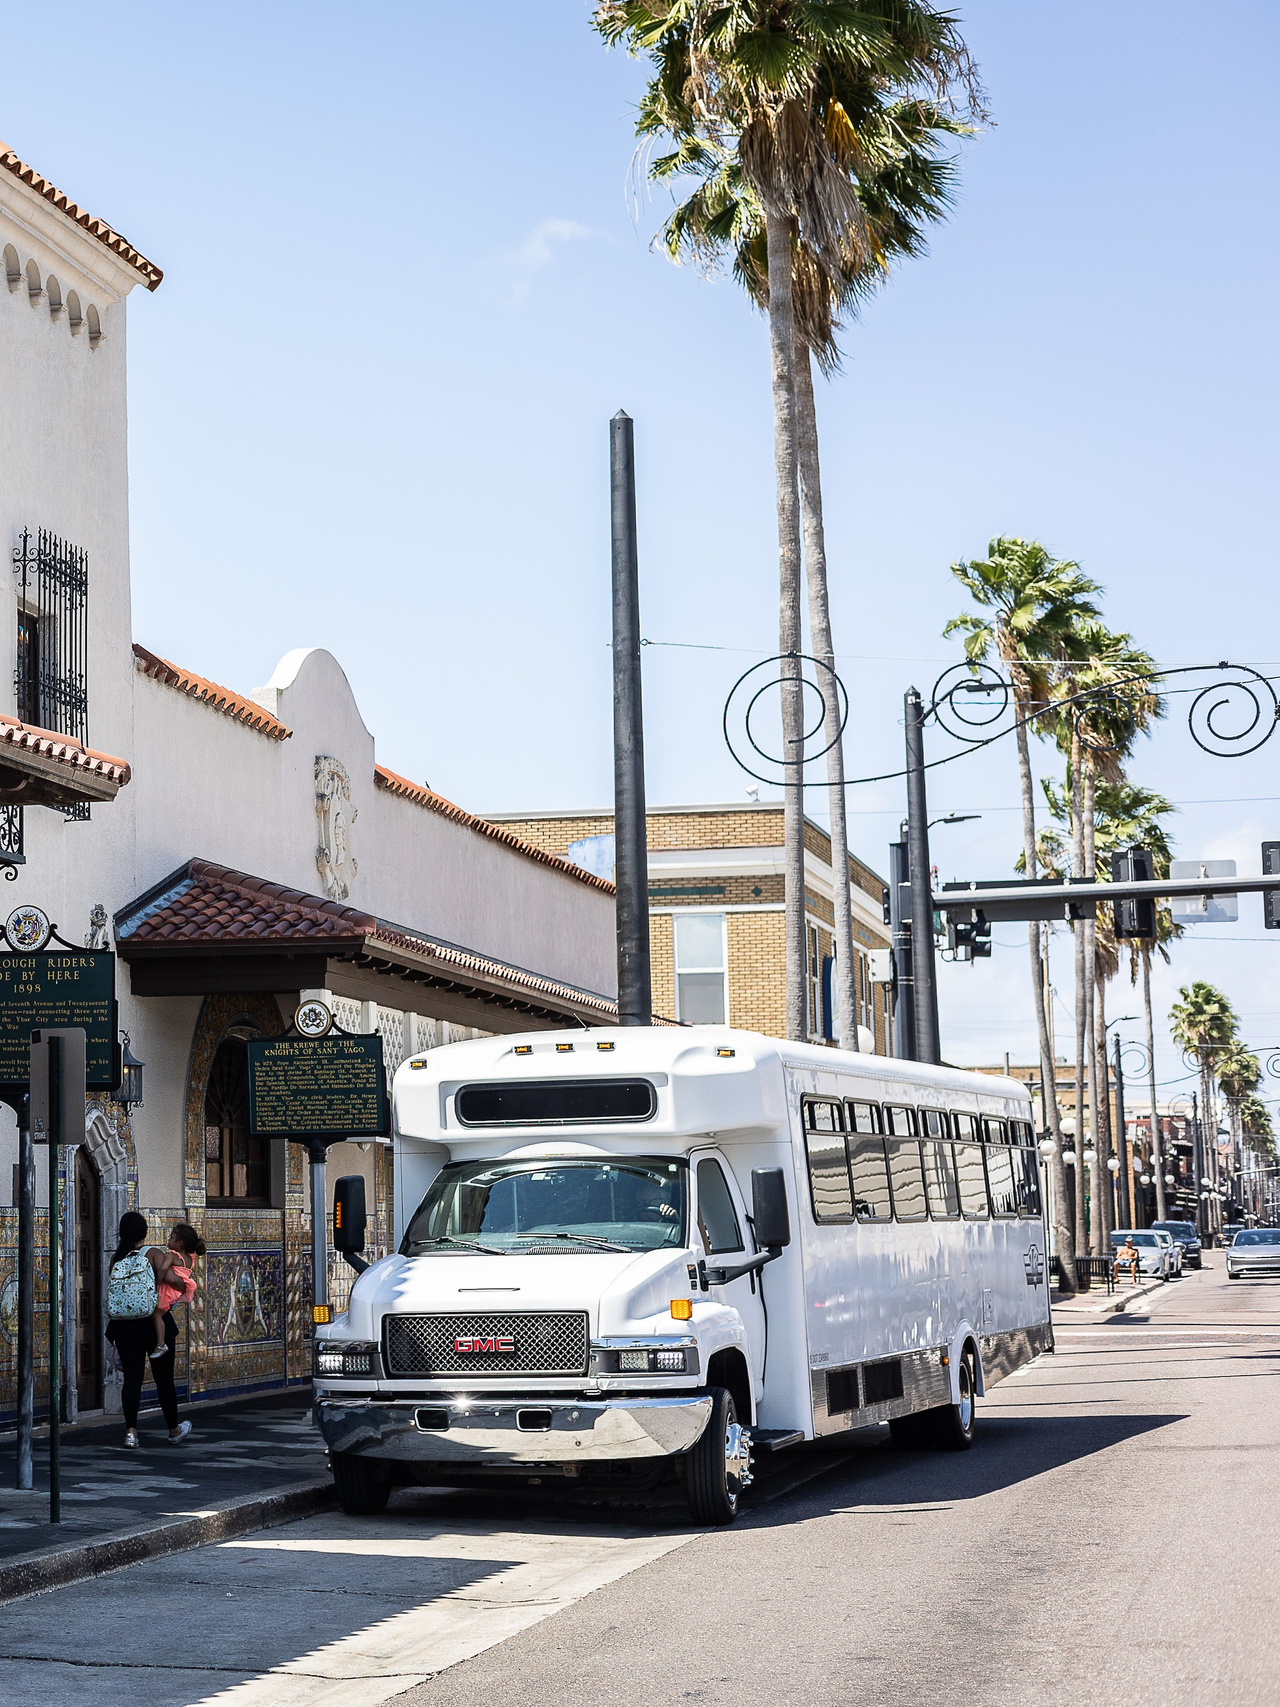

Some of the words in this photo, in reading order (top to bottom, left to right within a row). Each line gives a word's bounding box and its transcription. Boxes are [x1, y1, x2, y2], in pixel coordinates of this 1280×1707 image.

[48, 958, 95, 967] RIDERS
[22, 971, 35, 981] BY
[48, 971, 79, 980] HERE
[14, 984, 41, 994] 1898
[454, 1337, 514, 1352] GMC
